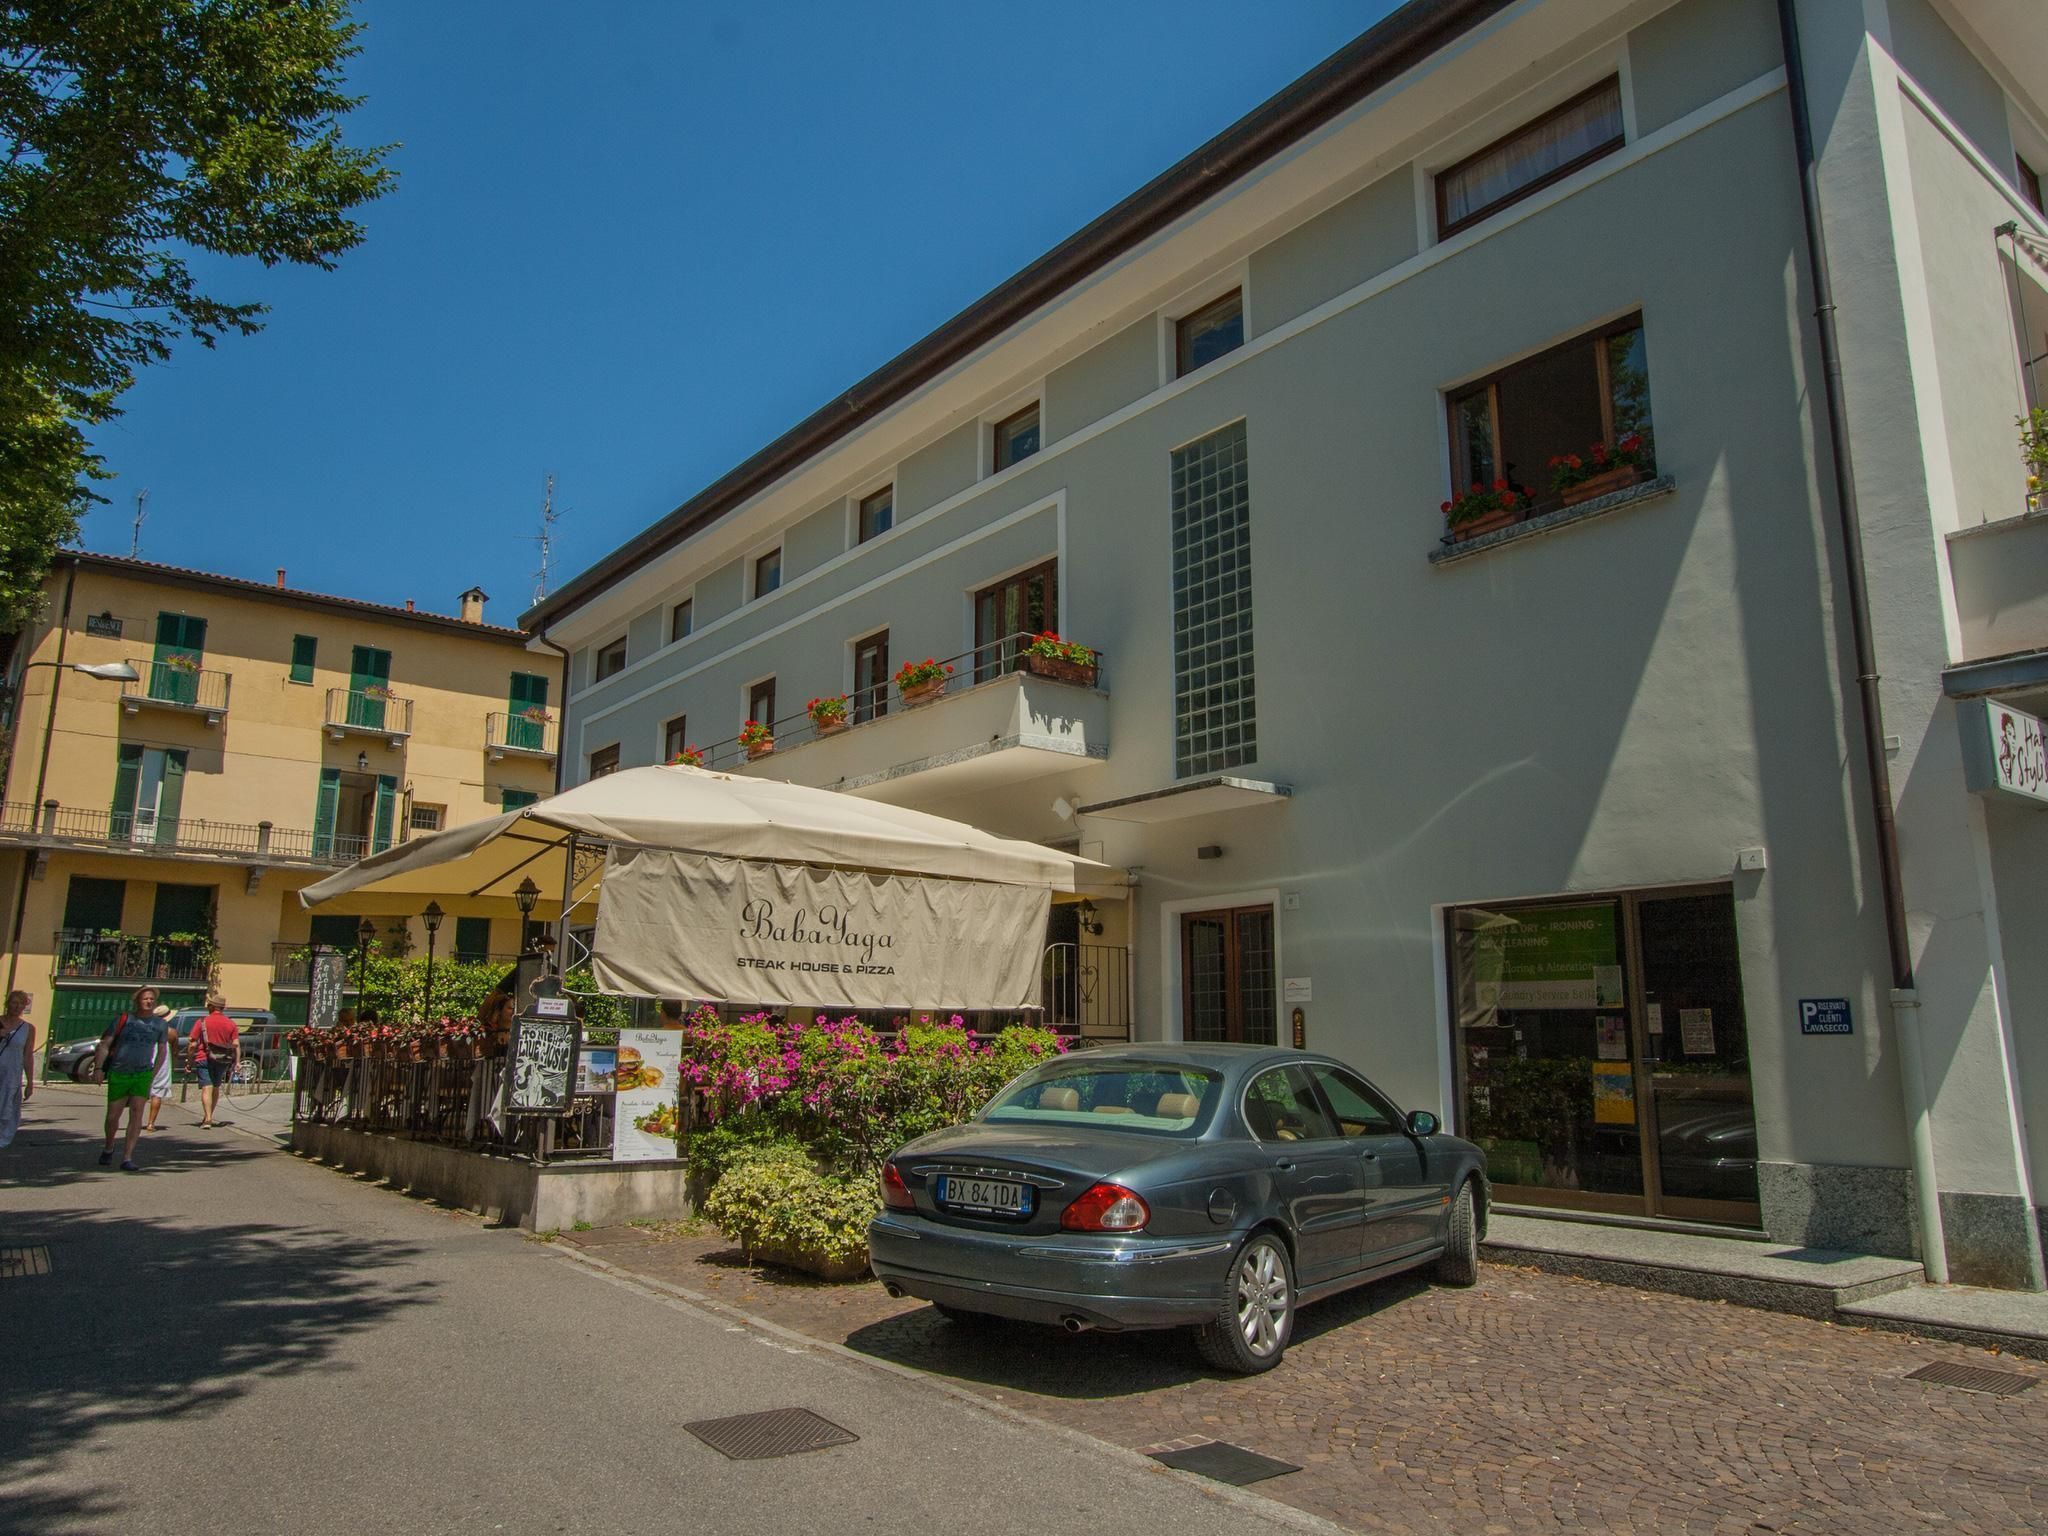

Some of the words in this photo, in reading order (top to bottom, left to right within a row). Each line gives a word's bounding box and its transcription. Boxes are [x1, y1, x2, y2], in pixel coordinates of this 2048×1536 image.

[1550, 919, 1595, 931] IRONING
[1500, 936, 1550, 949] CLEANING
[737, 957, 786, 971] STEAK
[790, 961, 839, 973] HOUSE
[842, 965, 852, 974] &
[856, 965, 895, 975] PIZZA
[1536, 989, 1570, 1001] Service
[1802, 1002, 1817, 1025] P
[1819, 1014, 1842, 1023] CLIENTI
[1804, 1023, 1849, 1033] LAVASECCO
[948, 1180, 966, 1201] BX
[971, 1183, 1019, 1208] 841DA
